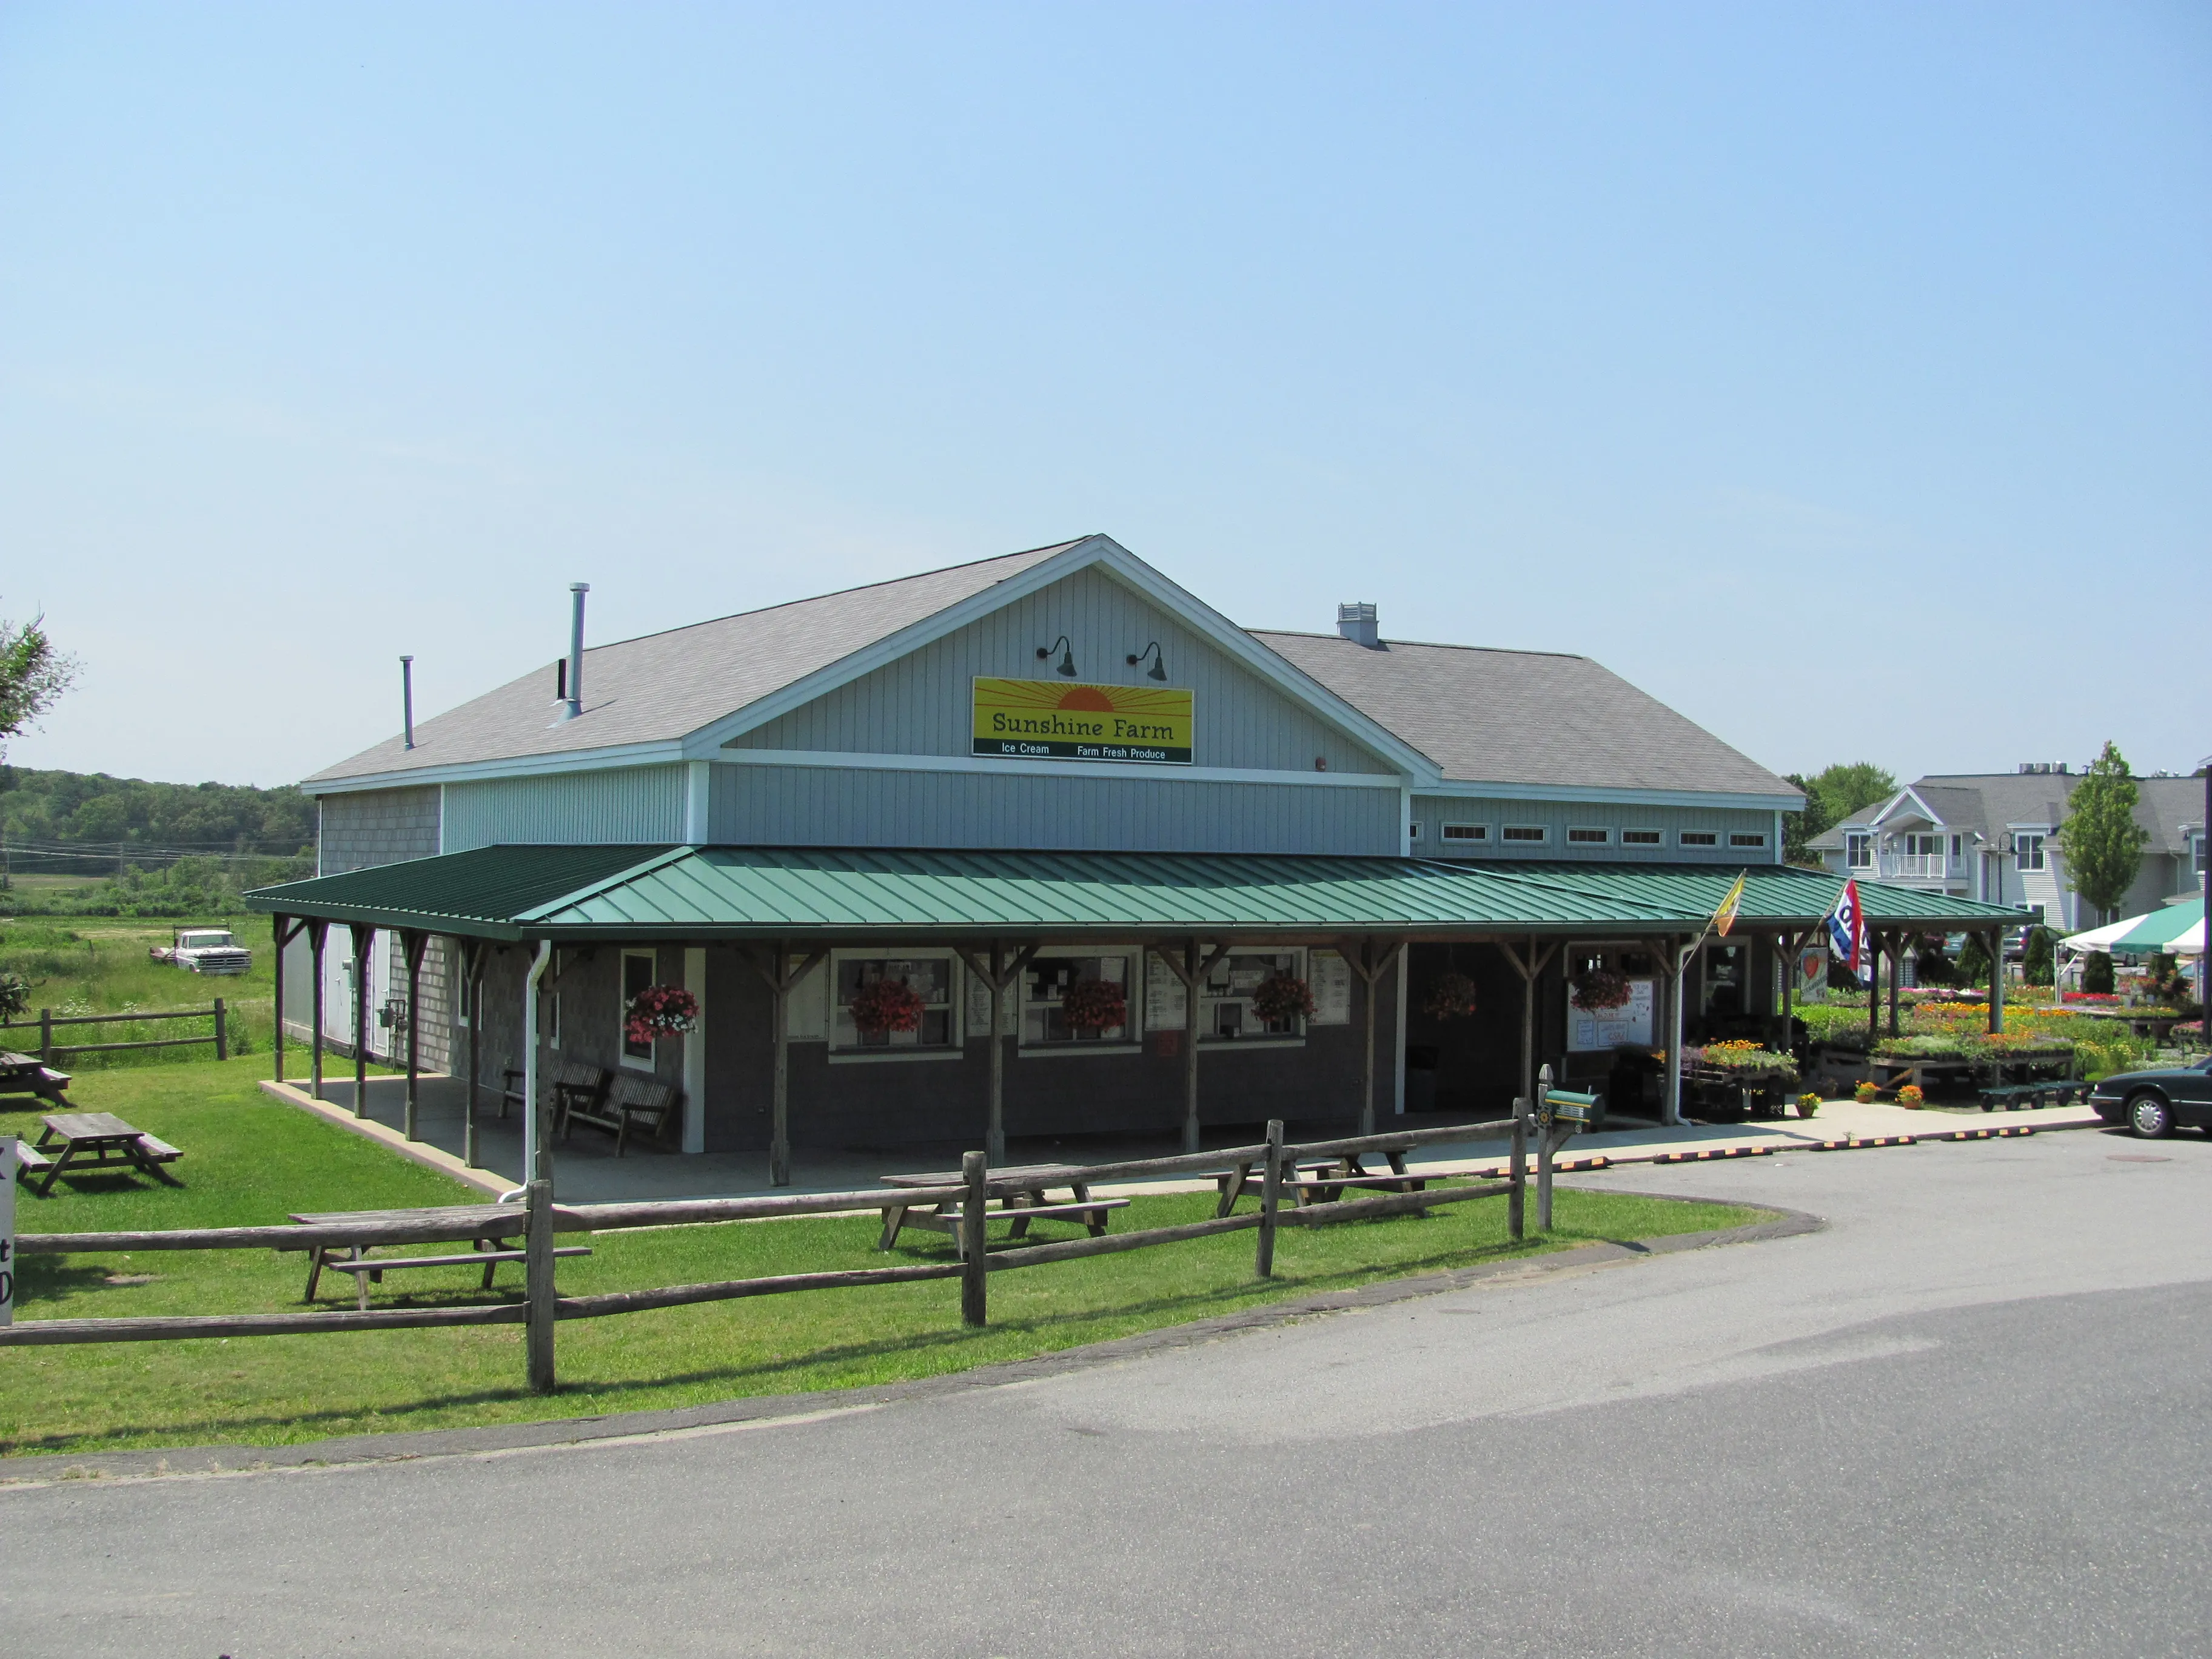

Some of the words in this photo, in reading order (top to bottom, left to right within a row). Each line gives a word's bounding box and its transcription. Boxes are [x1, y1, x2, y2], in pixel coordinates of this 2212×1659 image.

[993, 712, 1104, 736] Sunshine
[1113, 719, 1174, 740] Farm
[1002, 742, 1016, 752] Ice
[1020, 743, 1049, 754] Cream
[1078, 746, 1099, 756] Farm
[1103, 747, 1127, 757] Fresh
[1131, 748, 1165, 759] Produce
